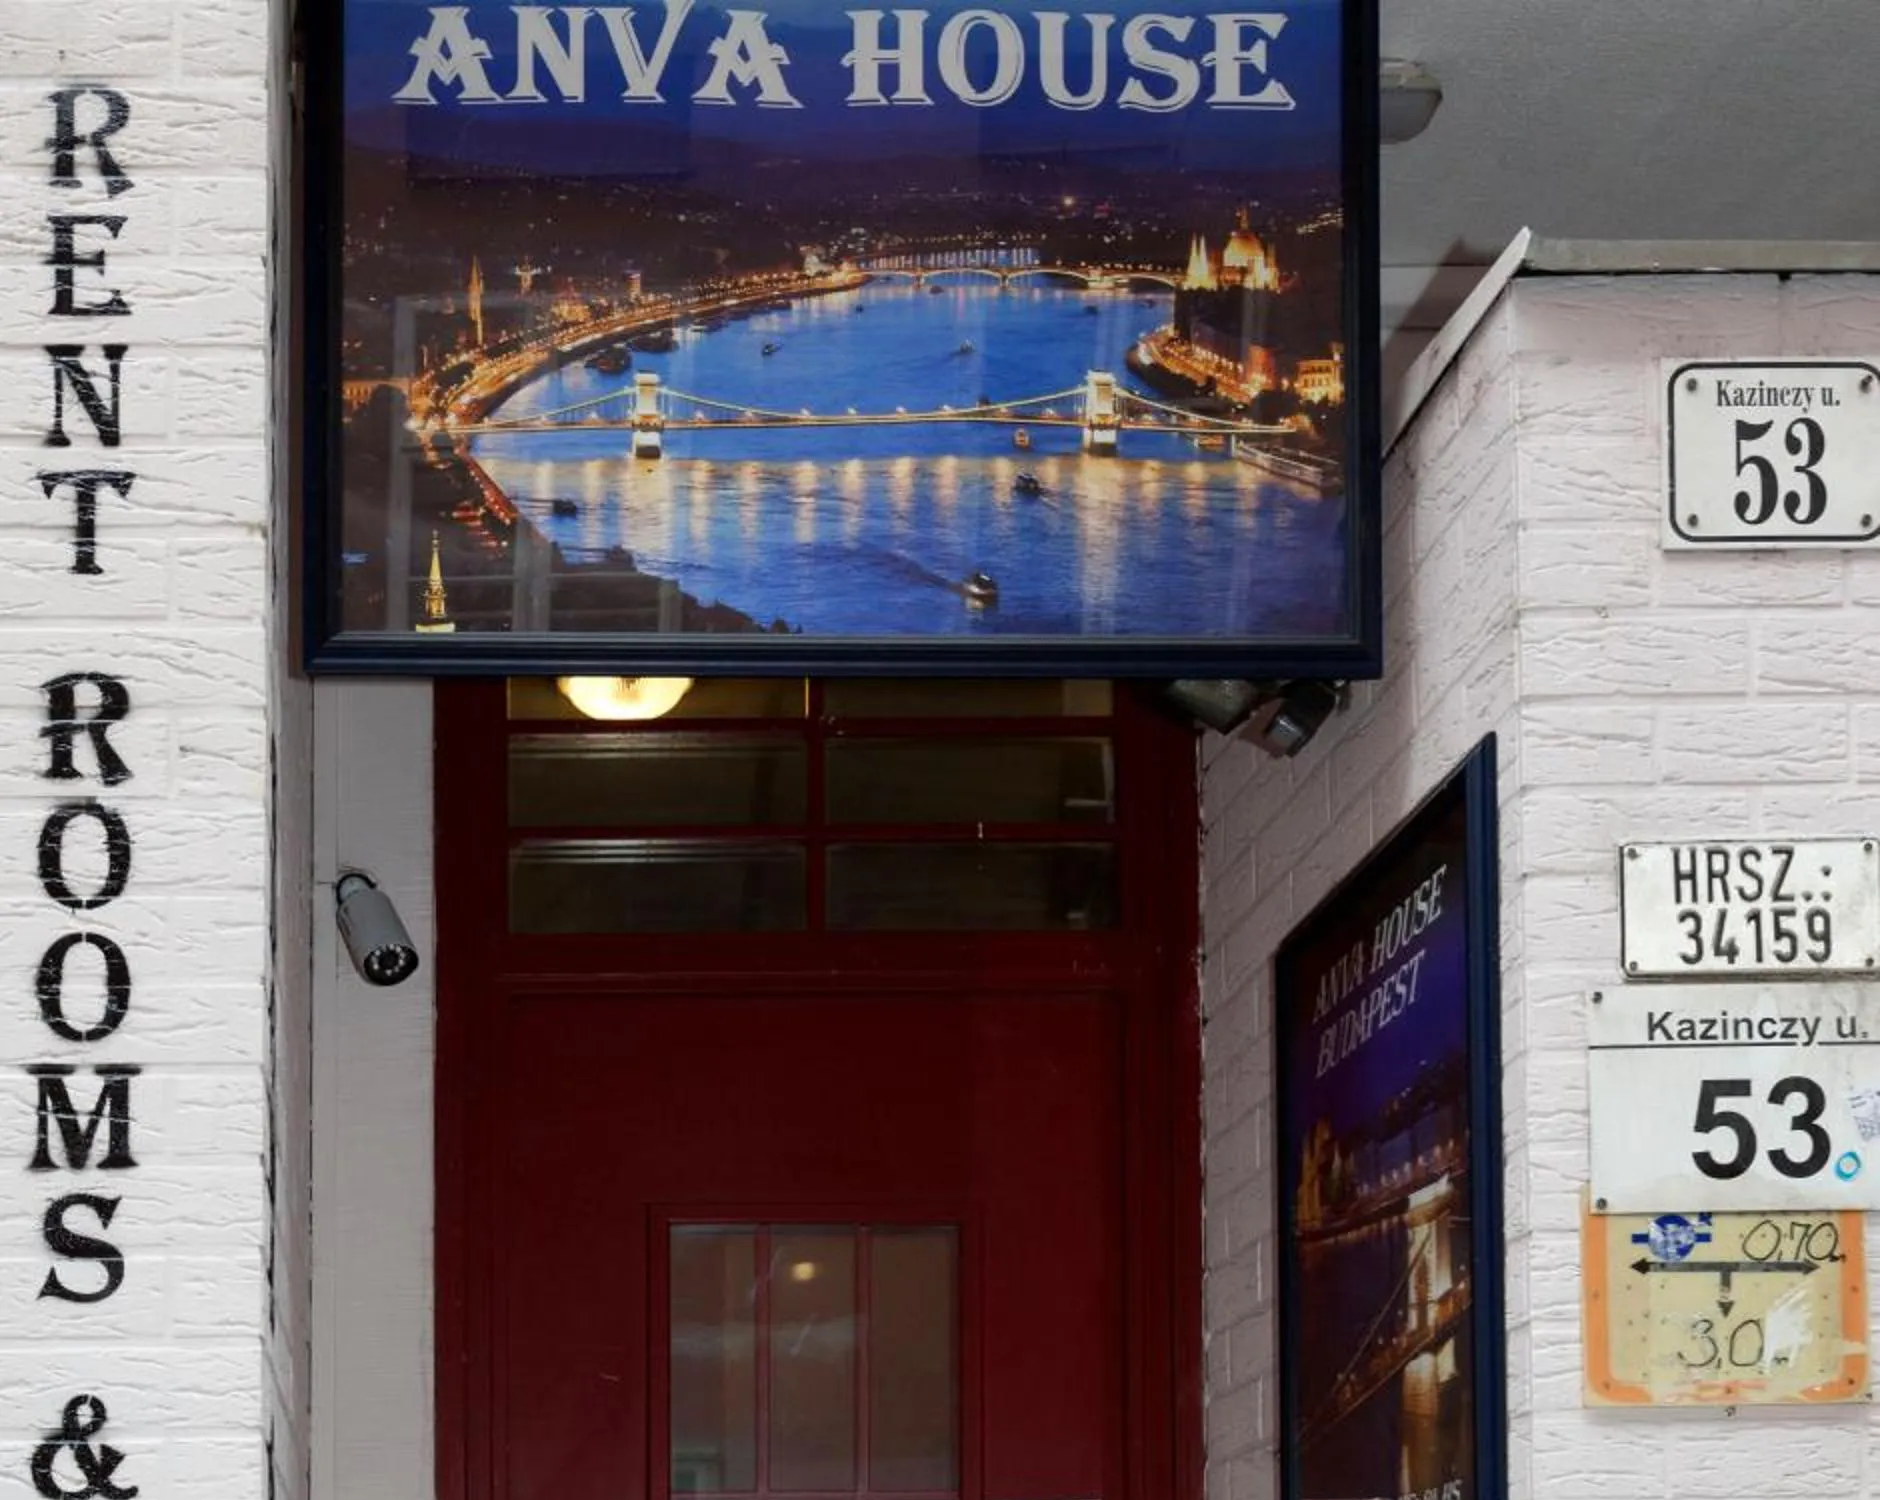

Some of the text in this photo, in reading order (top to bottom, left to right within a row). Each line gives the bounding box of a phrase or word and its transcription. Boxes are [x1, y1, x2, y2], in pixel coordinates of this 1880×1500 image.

[391, 0, 1297, 113] ANVA HOUSE
[38, 88, 135, 575] RENT
[1716, 379, 1841, 413] Kazinczy u.
[1733, 417, 1828, 525] 53
[1368, 863, 1448, 975] HOUSE
[1676, 907, 1832, 965] 34159
[28, 671, 140, 1303] ROOMS
[1315, 949, 1426, 1079] BUDAPEST
[1646, 1009, 1869, 1047] Kazinczy u.
[1690, 1075, 1833, 1180] 53
